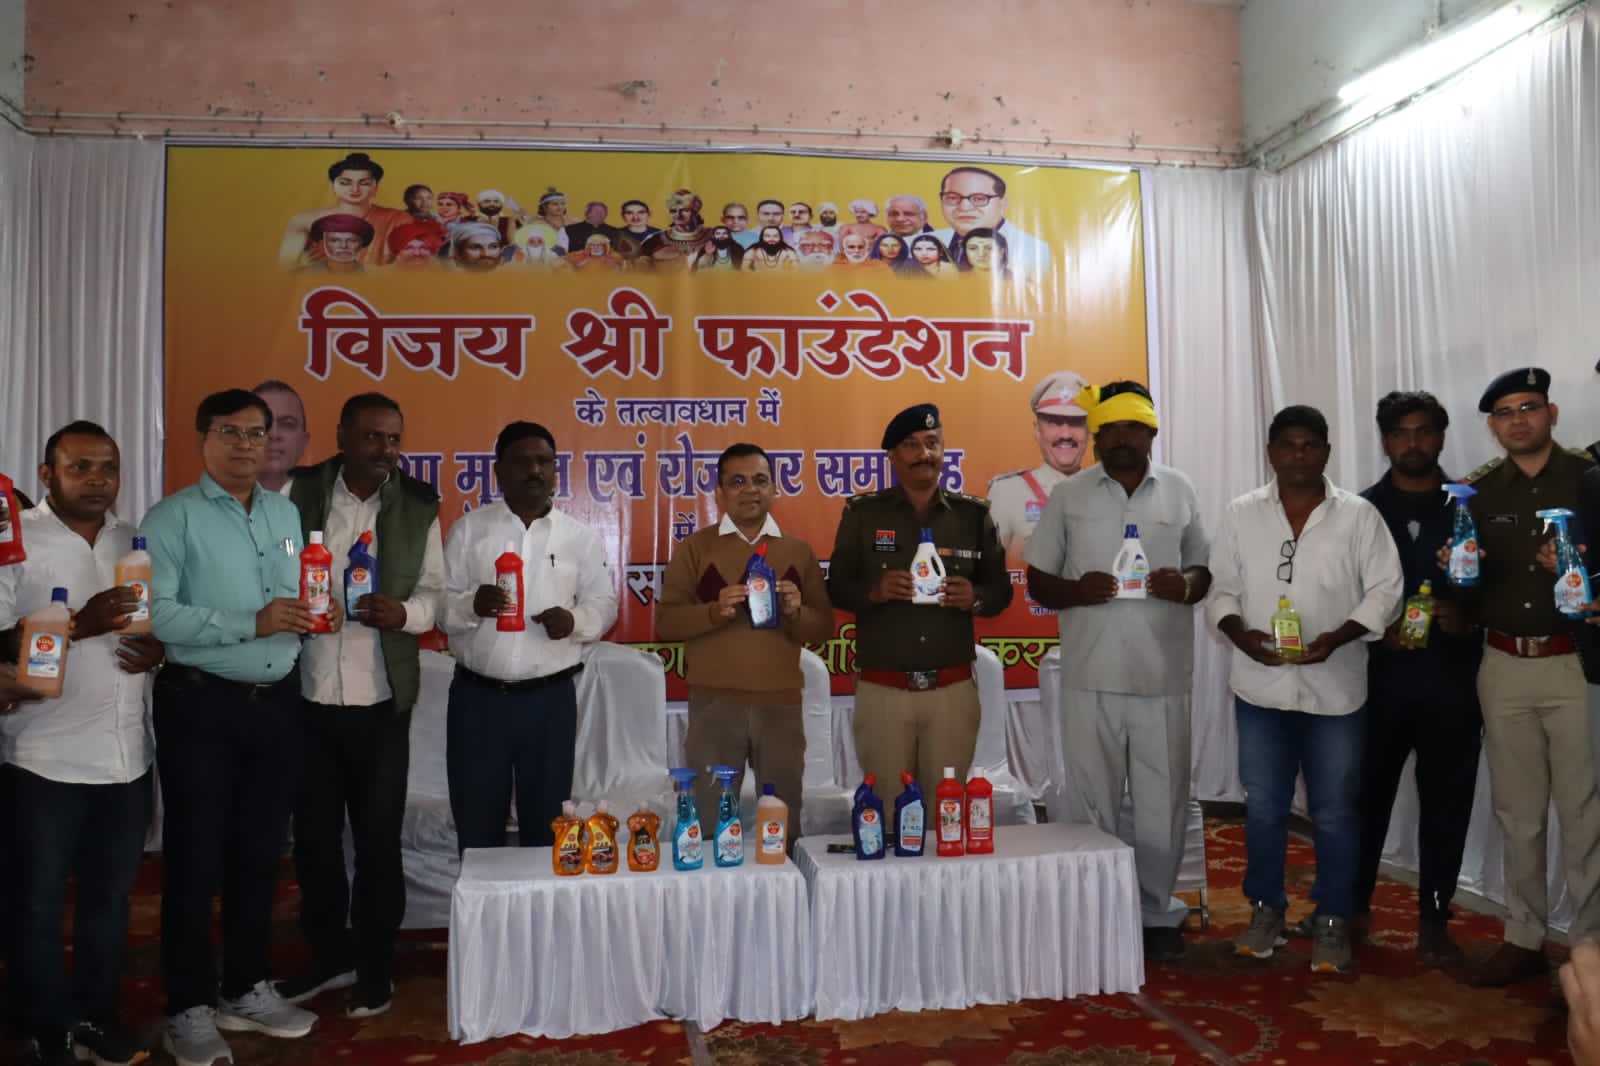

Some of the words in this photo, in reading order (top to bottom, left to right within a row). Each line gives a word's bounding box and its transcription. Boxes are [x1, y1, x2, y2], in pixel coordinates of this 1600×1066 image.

[300, 287, 535, 380] विजय
[562, 287, 671, 380] श्री
[696, 290, 1033, 382] फाउंडेशन
[575, 388, 606, 425] के
[757, 387, 781, 425] में
[585, 431, 645, 501] एवं
